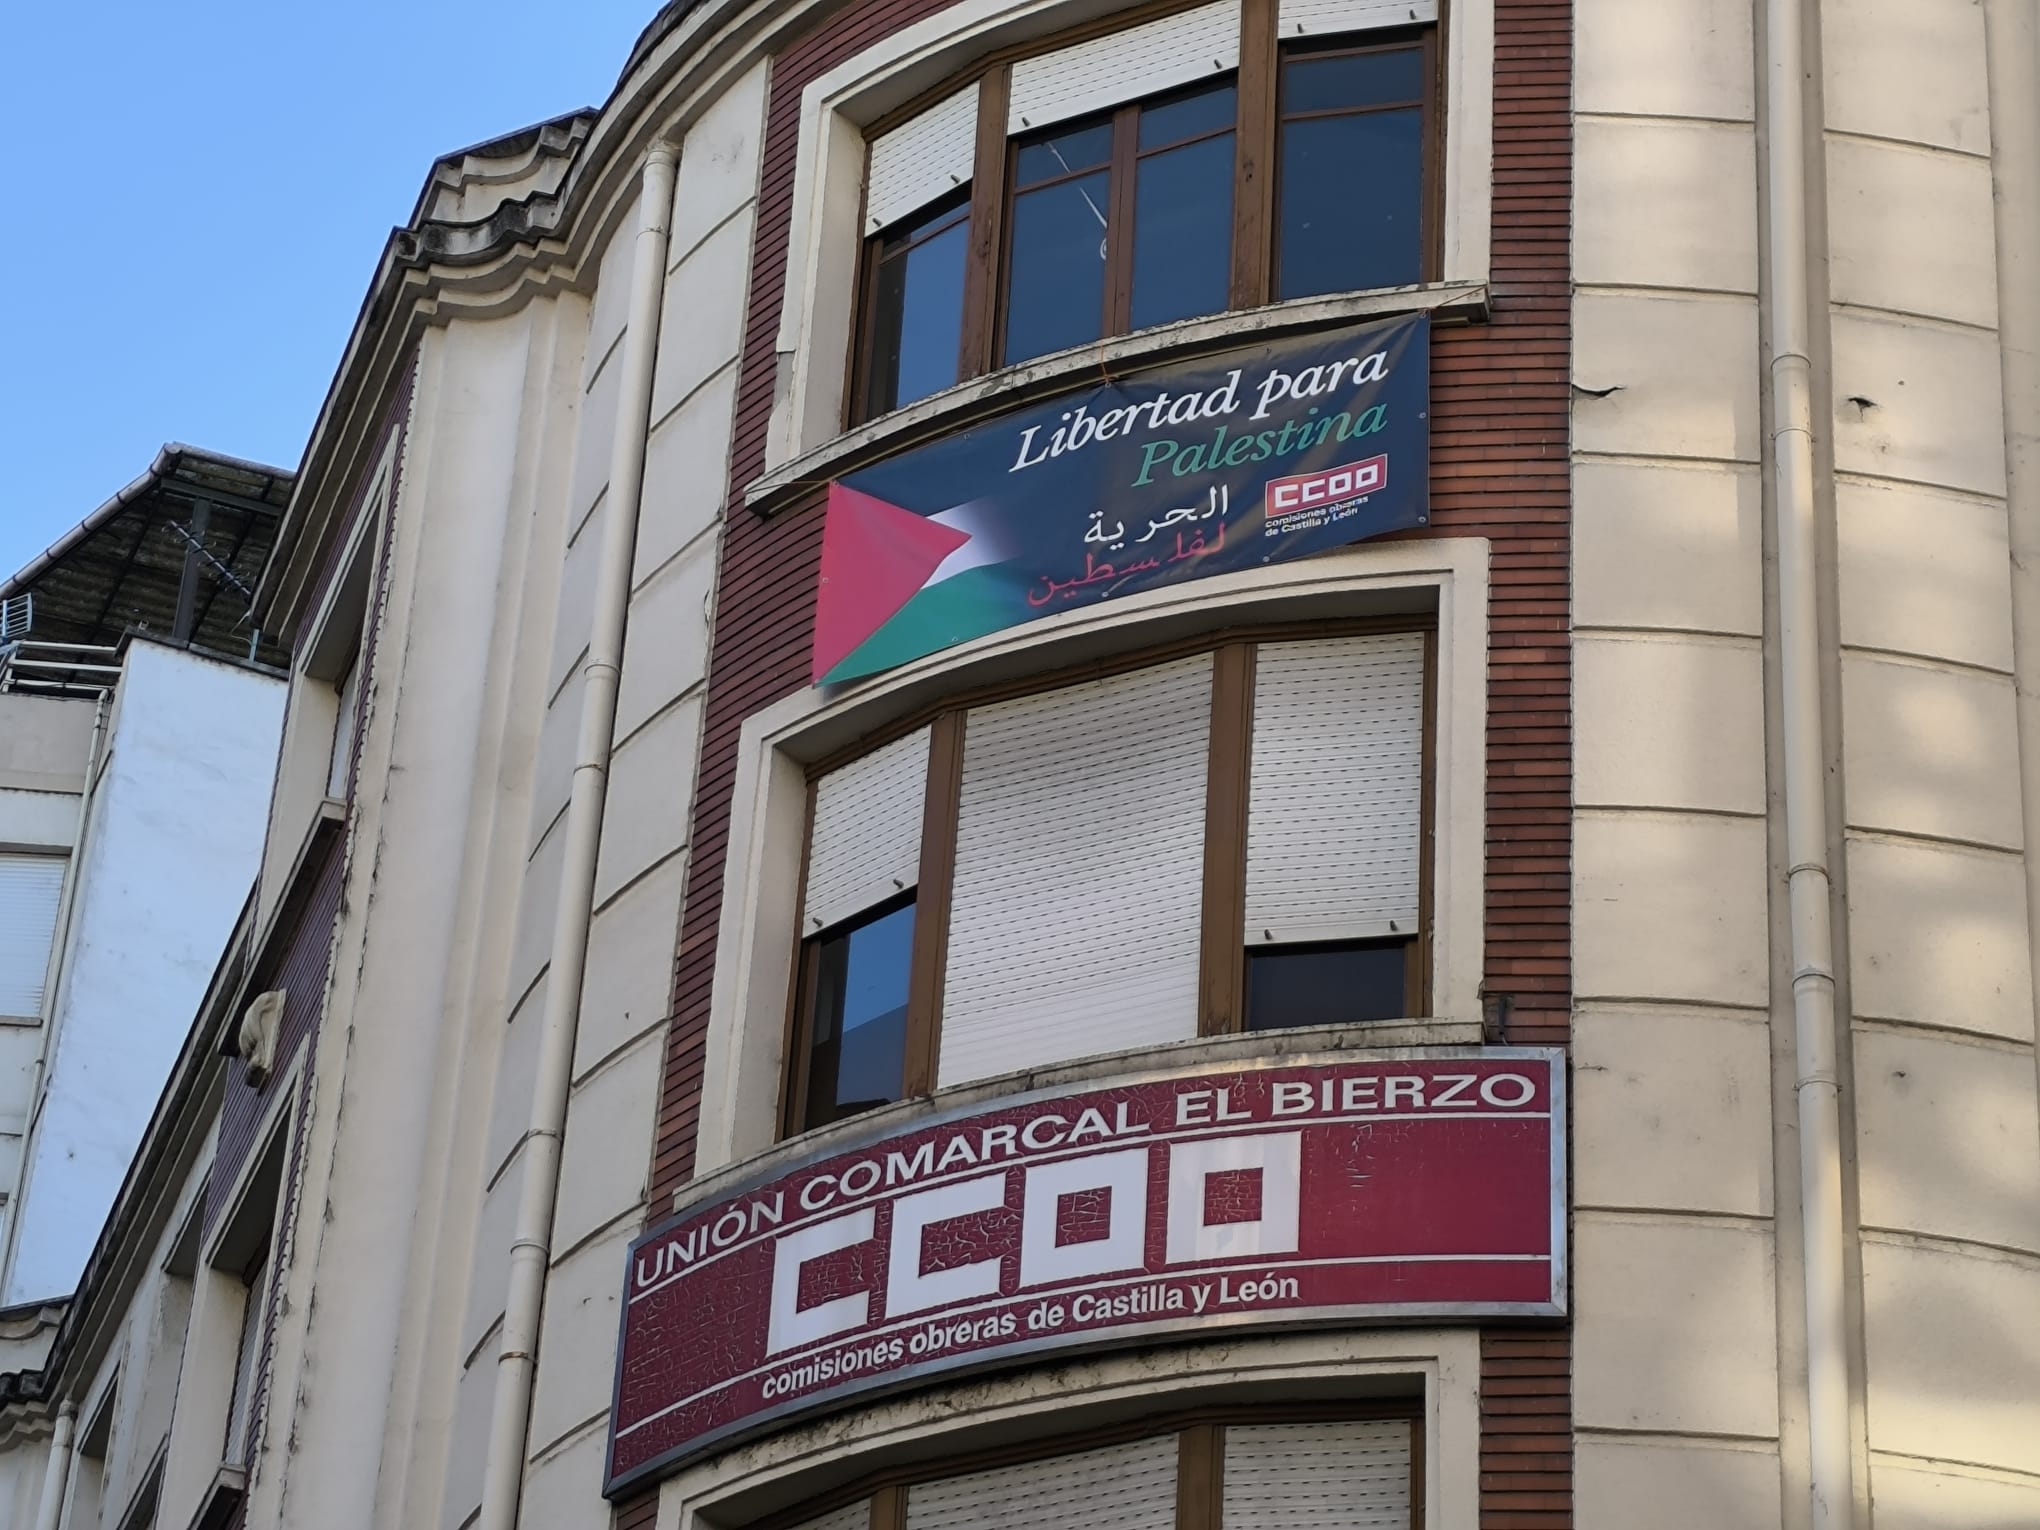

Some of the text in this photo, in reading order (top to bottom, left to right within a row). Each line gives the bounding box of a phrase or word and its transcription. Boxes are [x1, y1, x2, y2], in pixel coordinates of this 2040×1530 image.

[1008, 350, 1389, 473] Libertad para
[1131, 402, 1389, 488] Palestina
[1084, 484, 1228, 550] الحرية
[1264, 507, 1327, 528] comisiones
[1264, 507, 1358, 537] de Castilla y León
[1274, 463, 1379, 508] CCOO
[636, 1073, 1537, 1289] UNIÓN COMARCAL EL BIERZO
[765, 1130, 1302, 1359] CCOO
[761, 1271, 1300, 1400] comisiones obreras de Castilla y León
